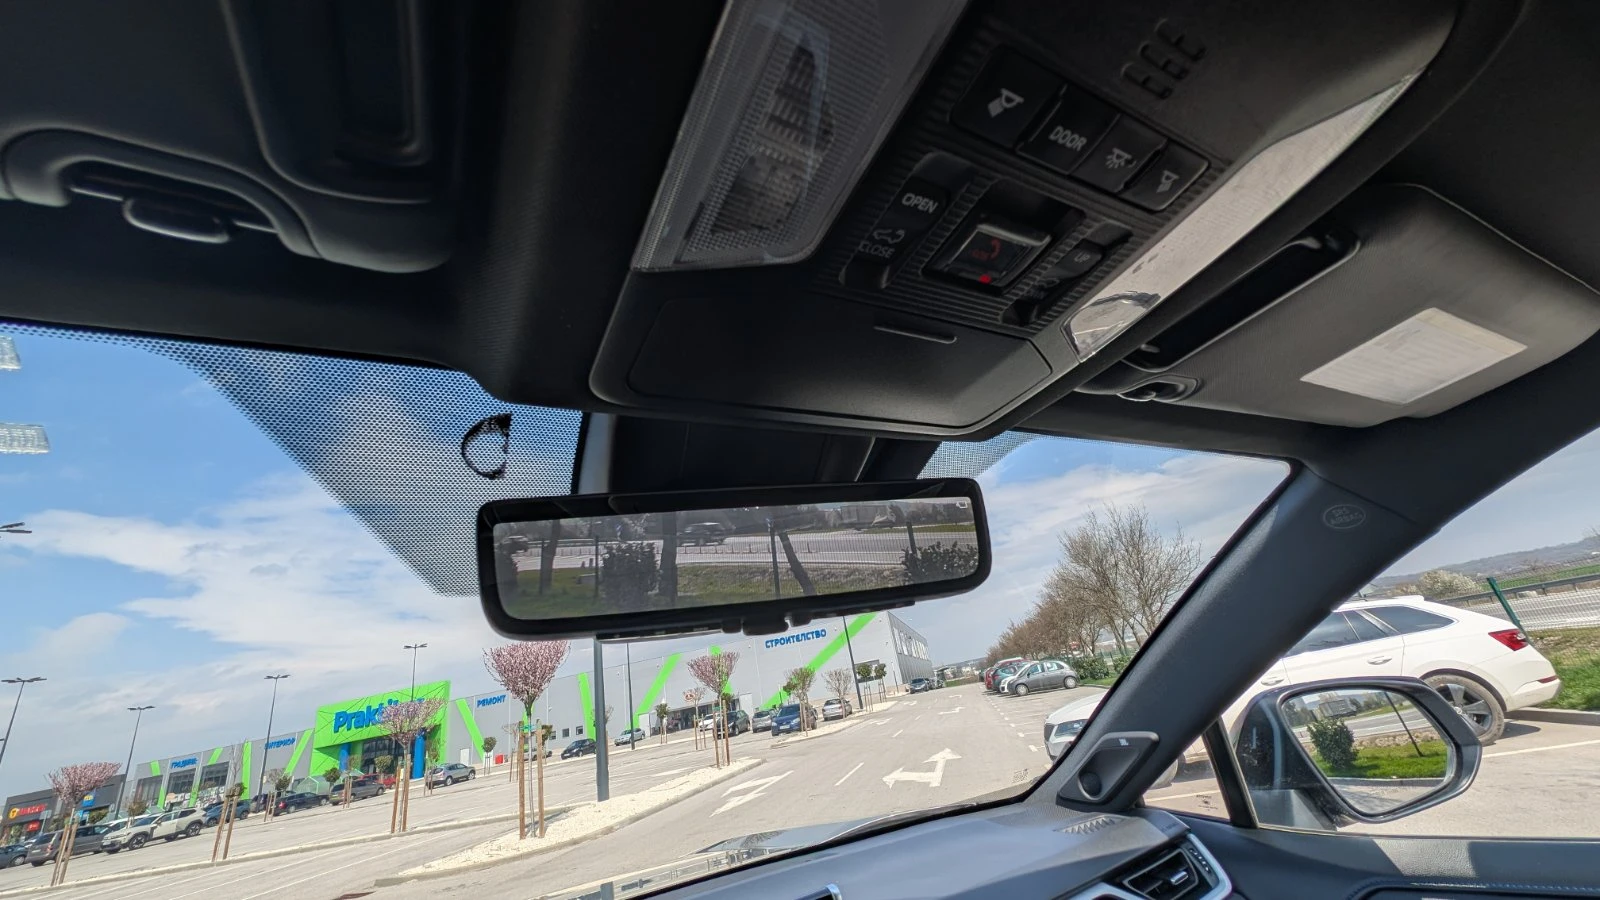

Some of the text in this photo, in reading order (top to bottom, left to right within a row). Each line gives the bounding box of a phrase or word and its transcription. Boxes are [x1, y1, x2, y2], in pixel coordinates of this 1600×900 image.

[1049, 125, 1087, 151] DOOR
[901, 192, 939, 214] OPEN
[858, 239, 896, 259] CLOSE
[765, 629, 827, 648] СТРОИТЕЛСТВО
[476, 694, 506, 708] РЕМОНТ
[333, 698, 425, 733] Prakt
